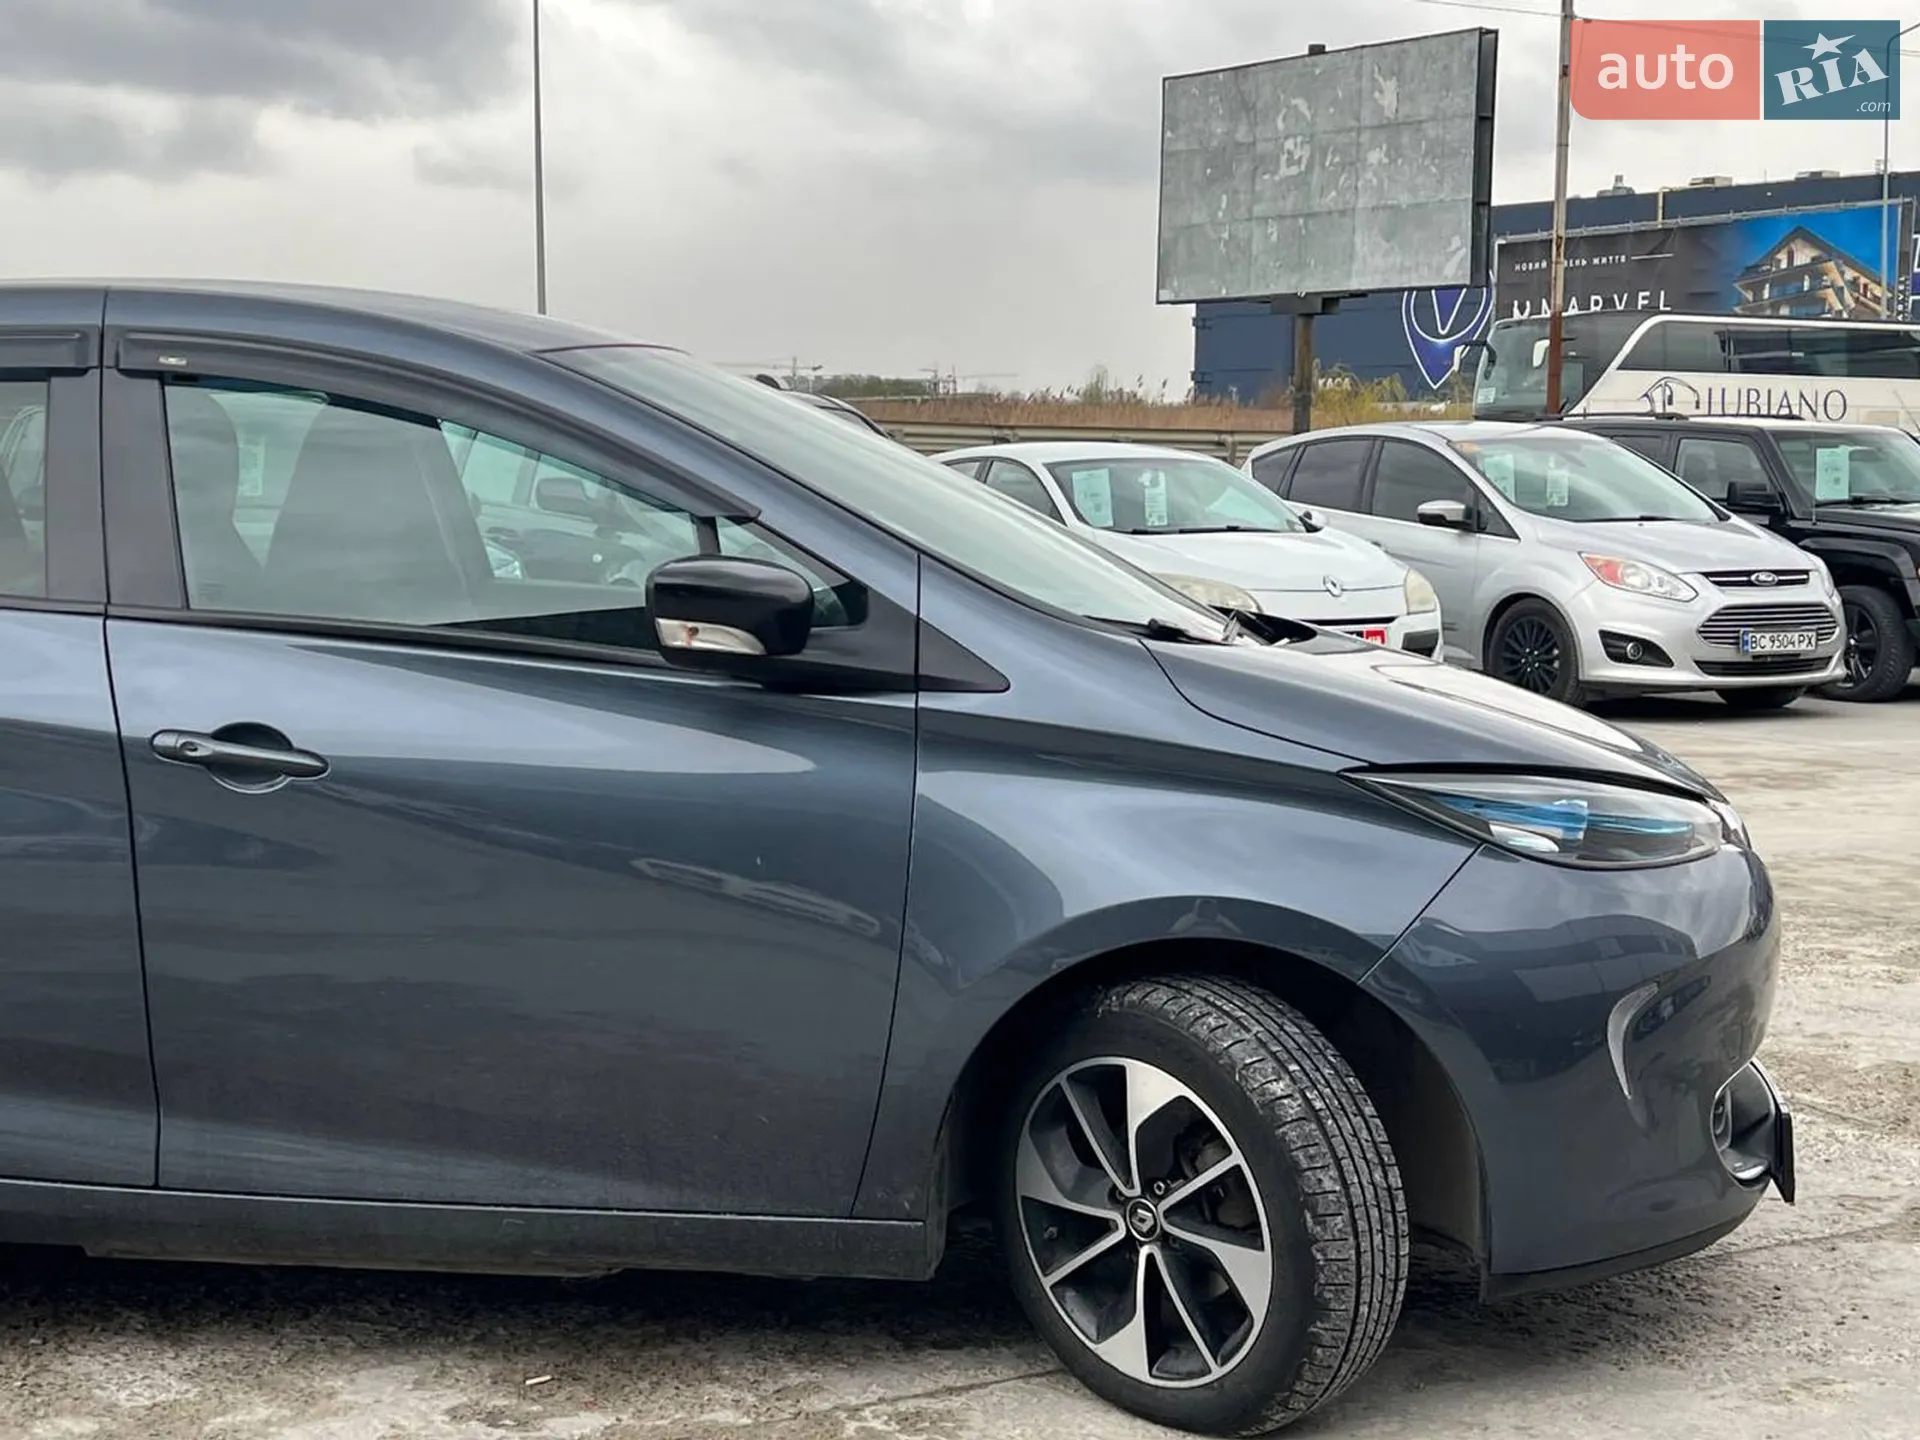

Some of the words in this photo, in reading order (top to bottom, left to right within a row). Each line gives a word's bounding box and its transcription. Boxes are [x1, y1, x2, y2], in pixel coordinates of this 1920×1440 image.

[1514, 261, 1548, 271] НОВИЙ
[1592, 254, 1627, 265] ЖИТТЯ
[1750, 635, 1767, 649] BC
[1769, 634, 1796, 649] 9504
[1798, 634, 1814, 648] PX
